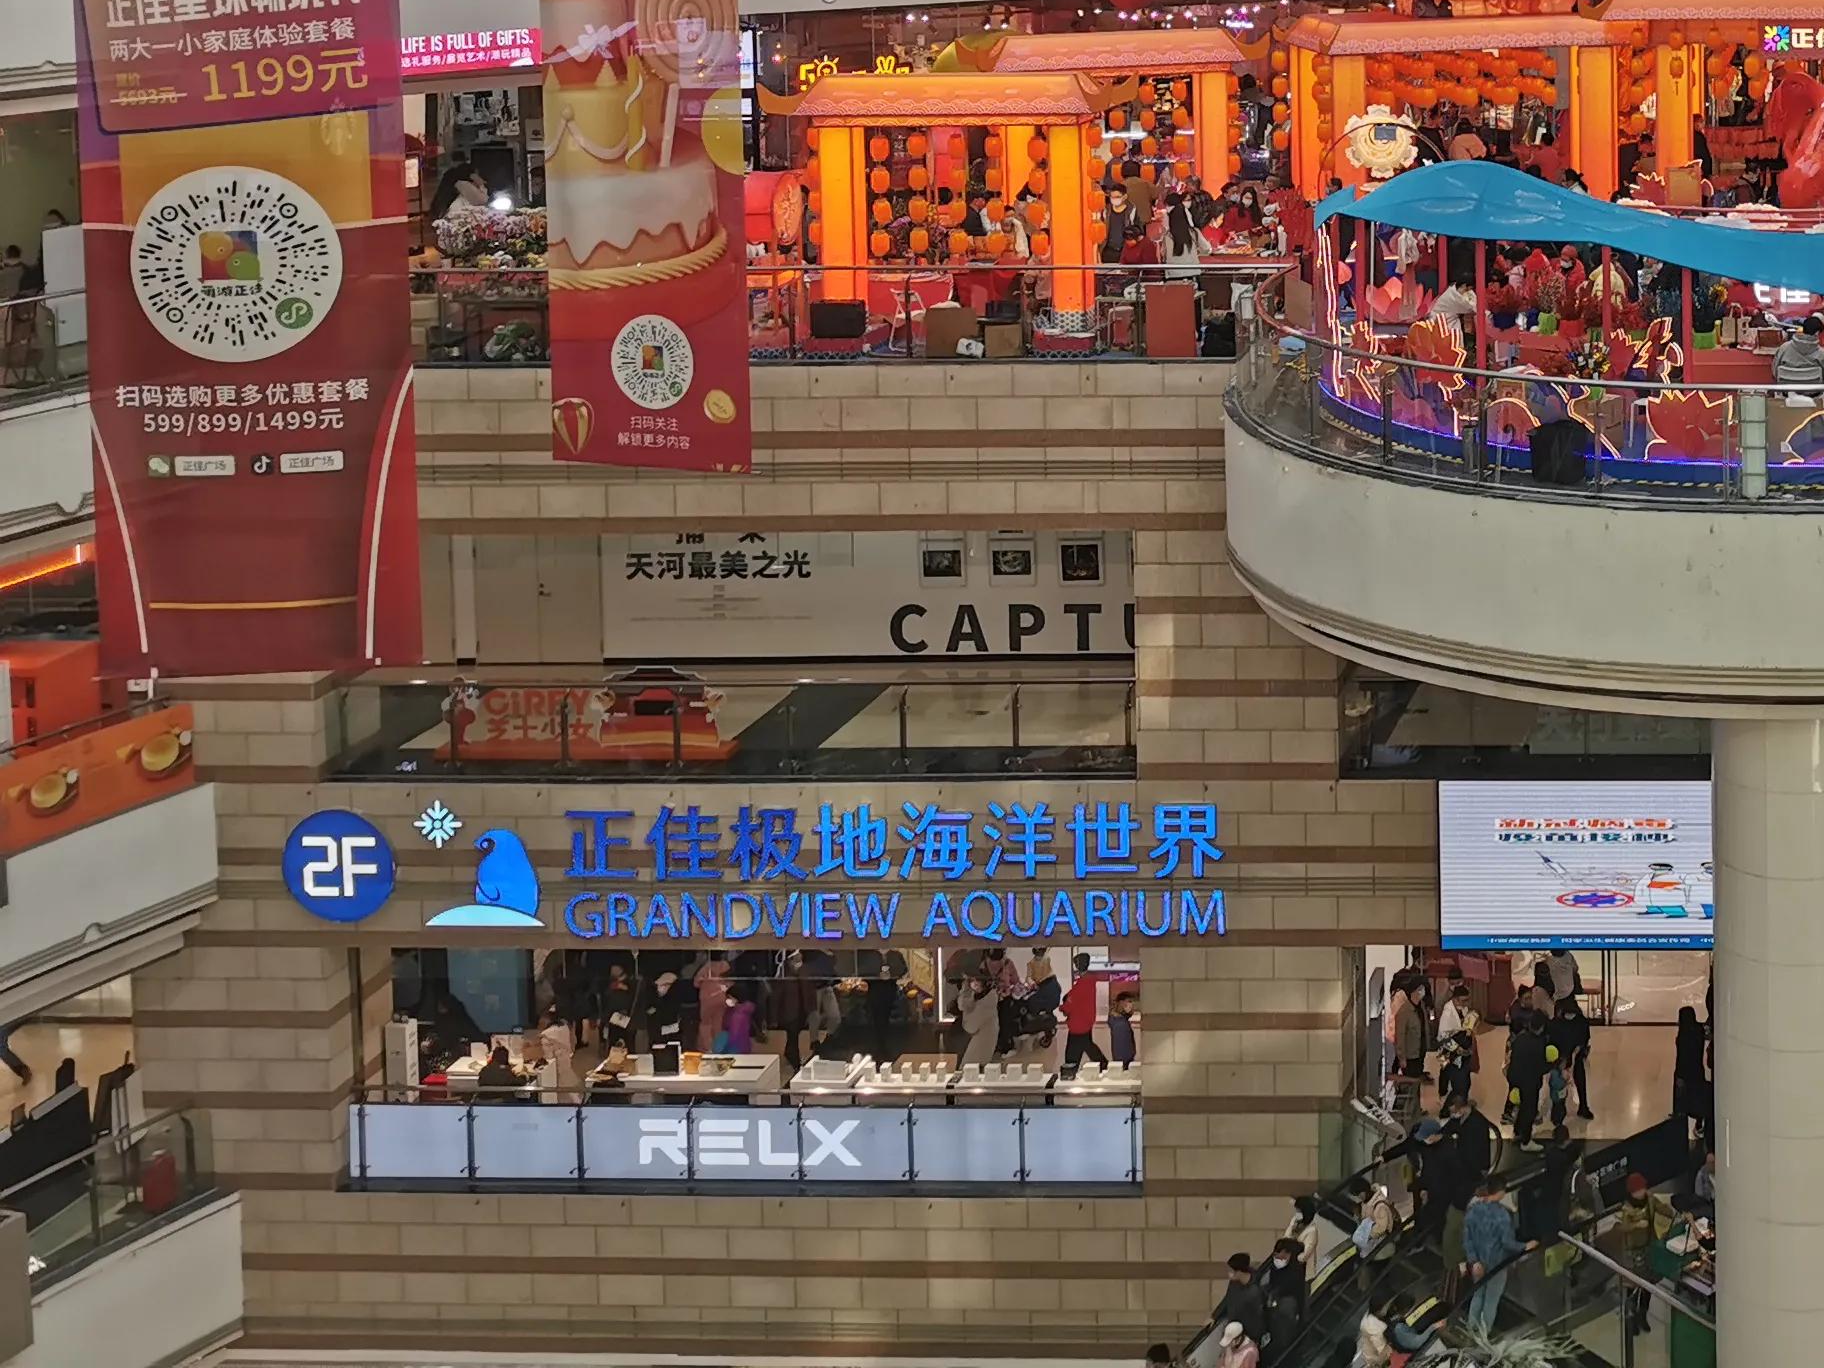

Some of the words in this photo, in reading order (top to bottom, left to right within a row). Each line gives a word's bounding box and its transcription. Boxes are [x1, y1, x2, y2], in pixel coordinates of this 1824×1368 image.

[109, 17, 356, 61] 两大一小家庭体验套餐
[401, 37, 426, 54] LIFE
[430, 36, 443, 52] IS
[447, 33, 475, 50] FULL
[478, 31, 493, 48] OF
[496, 29, 534, 46] GIFTS.
[200, 48, 368, 102] 1199元
[116, 378, 369, 407] 扫码选购更多优惠套餐
[143, 408, 344, 436] 599/899/1499元
[630, 416, 678, 431] 扫码关注
[618, 432, 690, 449] 解锁更多内容
[182, 460, 226, 472] 正佳广场
[288, 456, 335, 469] 正佳广场
[625, 551, 812, 580] 天河最美之光
[563, 801, 1223, 882] 正佳极地海洋世界
[301, 836, 378, 898] 2F
[564, 892, 899, 940] GRANDVIEW
[921, 890, 1228, 940] AQUARIUM
[639, 1119, 862, 1166] RELX
